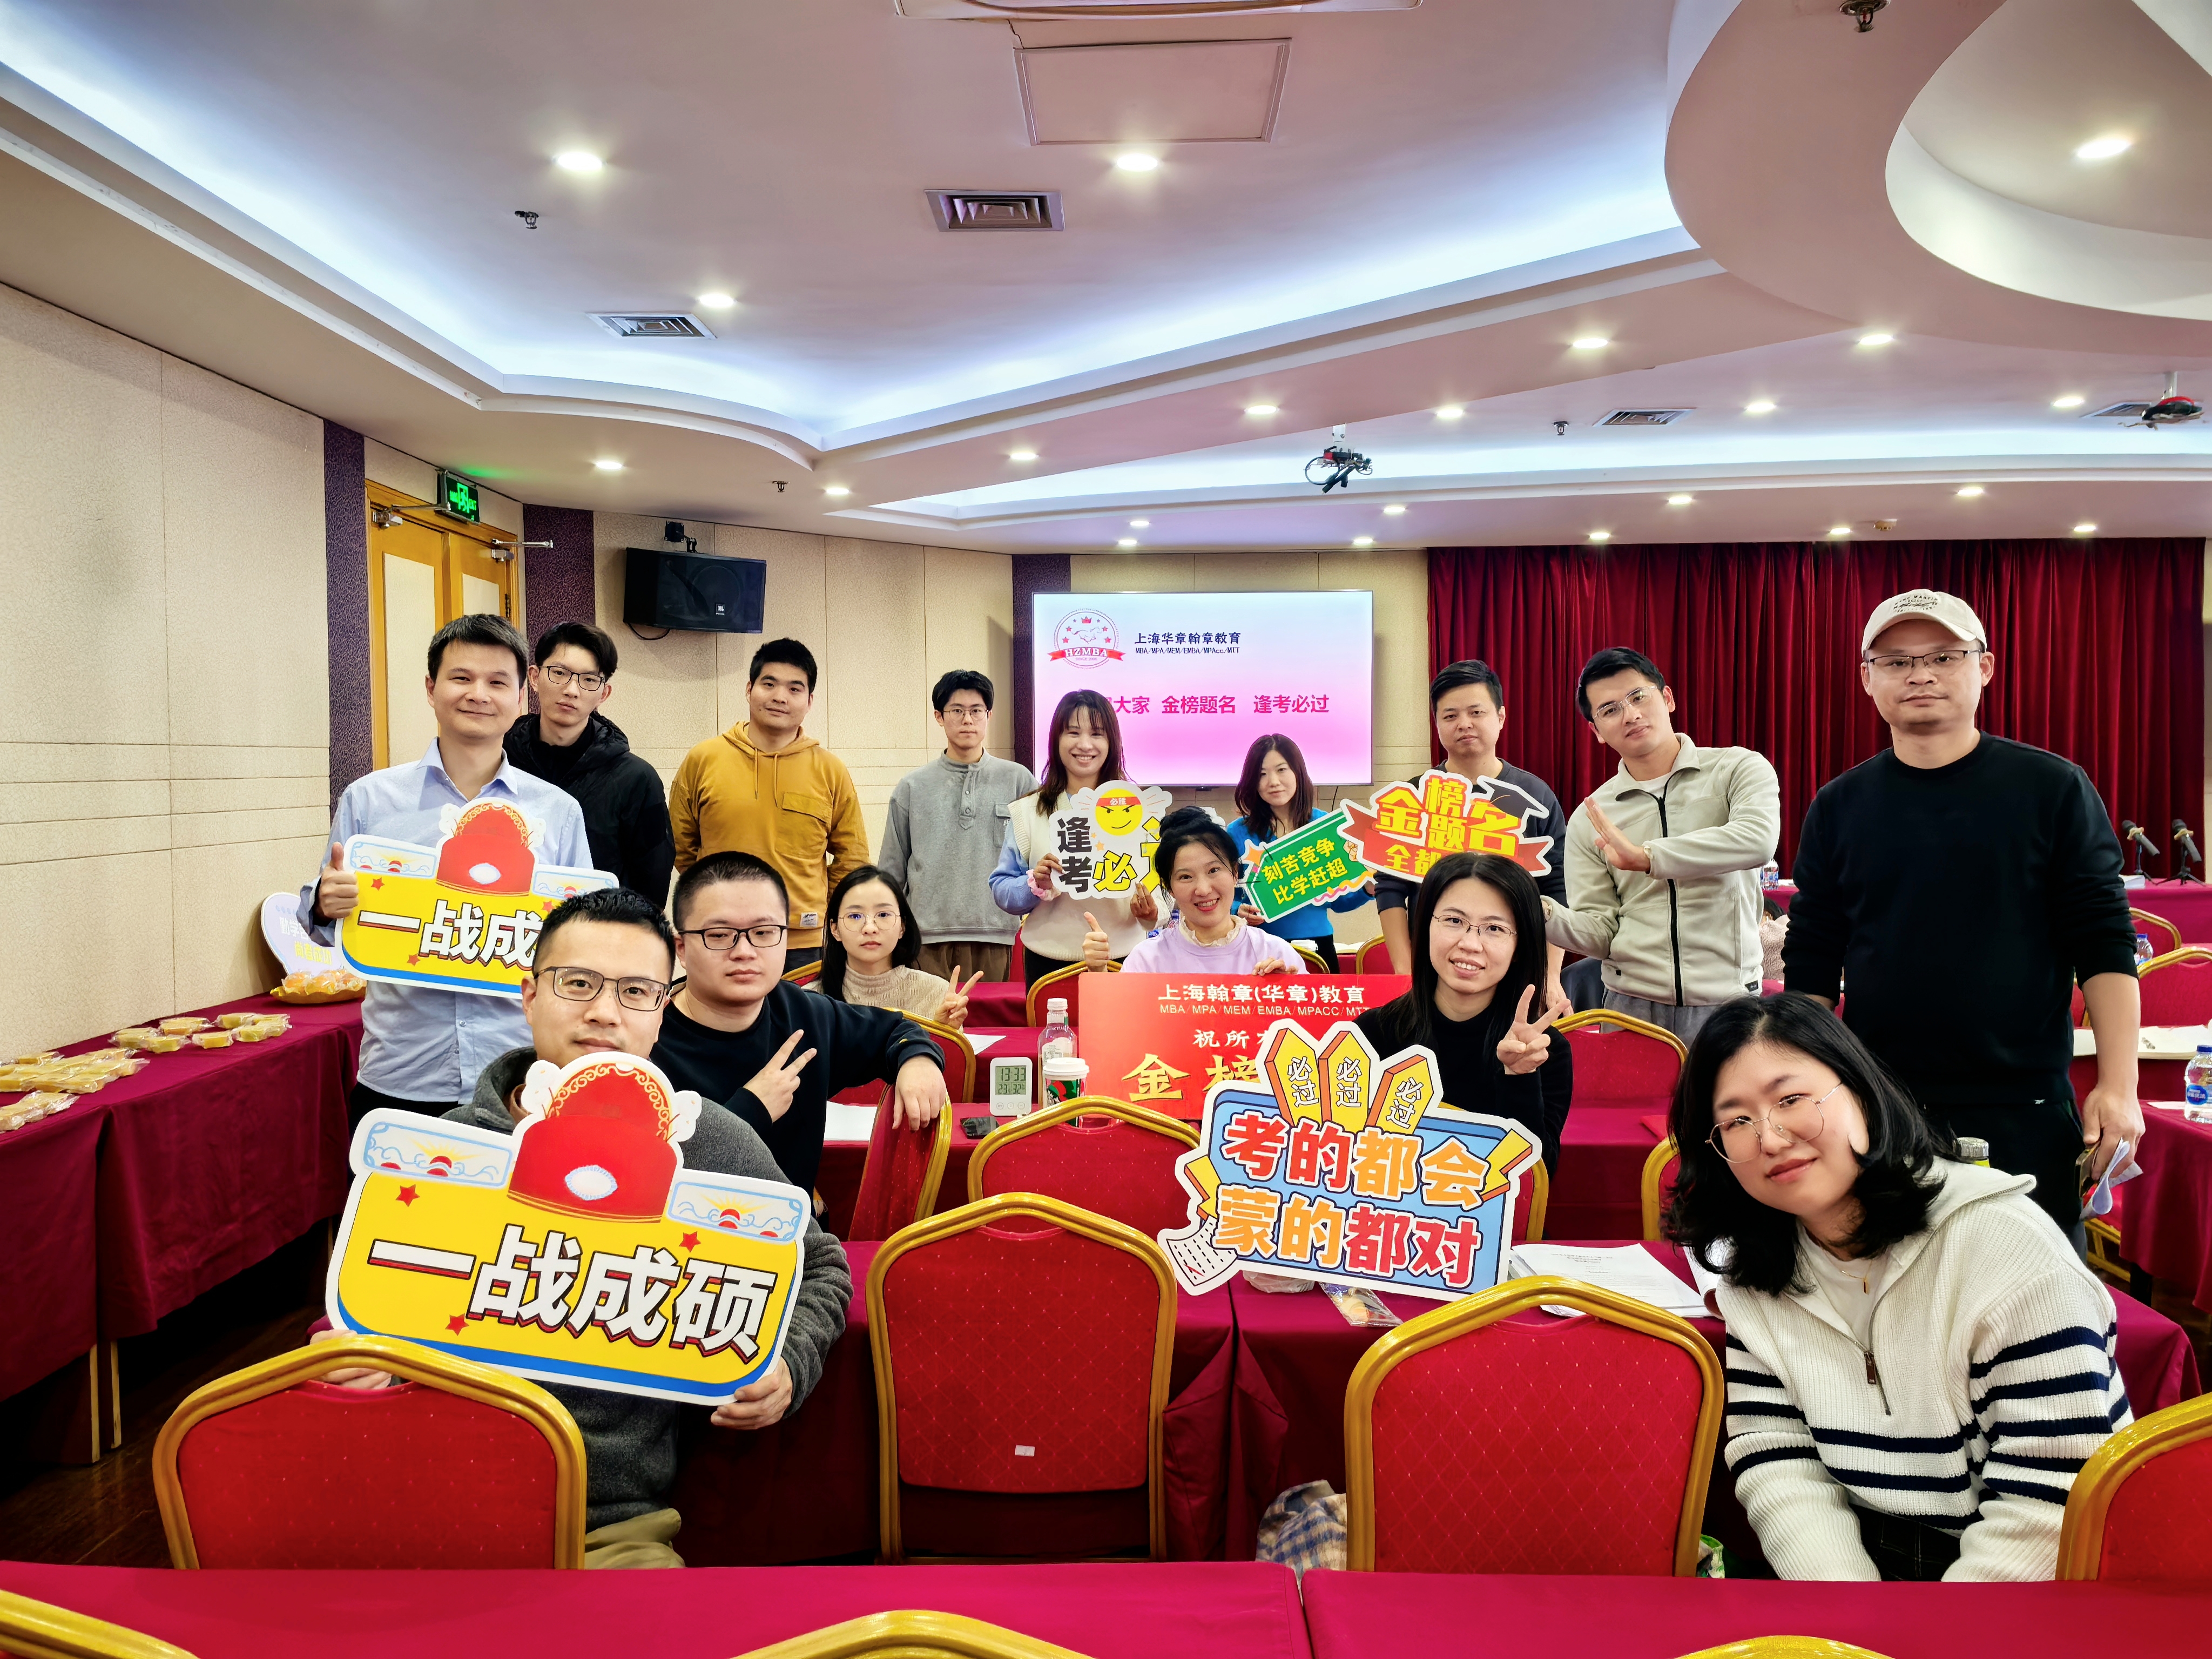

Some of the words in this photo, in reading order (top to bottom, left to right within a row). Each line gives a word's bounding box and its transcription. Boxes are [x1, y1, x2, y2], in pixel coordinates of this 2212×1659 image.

[1065, 648, 1108, 657] HZMBA
[1134, 632, 1241, 645] 上海华章翰章教育
[1107, 696, 1150, 714] 大家
[1162, 696, 1236, 713] 金榜题名
[1253, 694, 1329, 713] 逢考必过
[1110, 797, 1127, 805] 必胜
[1375, 777, 1519, 857] 金榜题名
[1262, 838, 1335, 885] 刻苦竞争
[1272, 857, 1348, 905] 比学赶超
[1158, 984, 1365, 1004] 上海翰章(华章)教育
[1001, 1067, 1026, 1081] 13:33
[1287, 1056, 1319, 1108] 必过
[1336, 1056, 1362, 1107] 必过
[1386, 1077, 1424, 1129] 必过
[1222, 1114, 1489, 1209] 考的都会
[1215, 1185, 1479, 1286] 蒙的都对
[367, 1224, 778, 1364] 一战成硕
